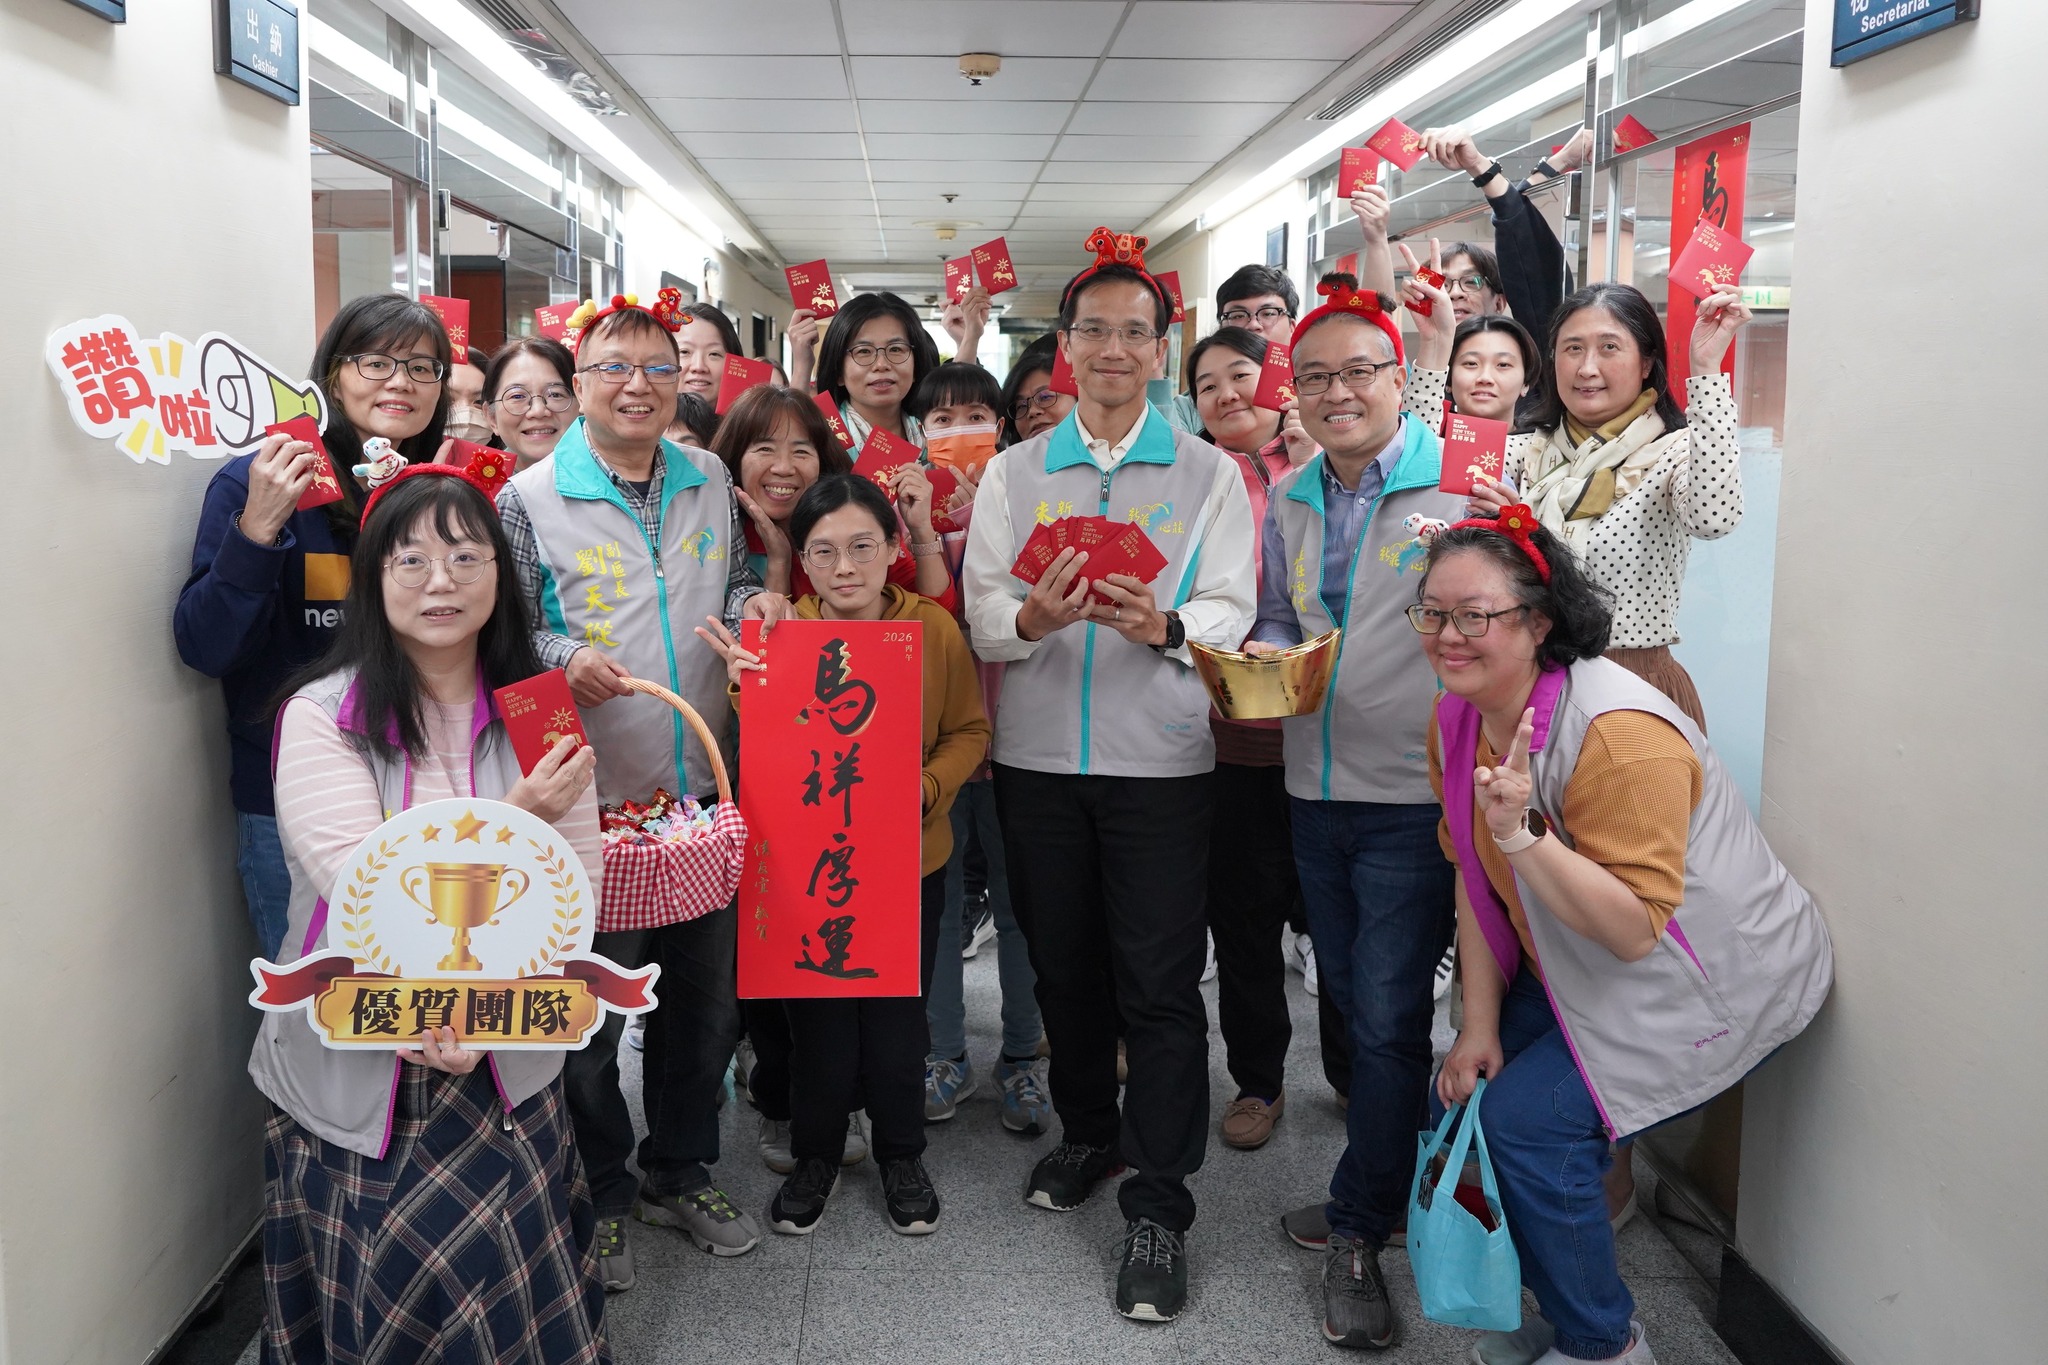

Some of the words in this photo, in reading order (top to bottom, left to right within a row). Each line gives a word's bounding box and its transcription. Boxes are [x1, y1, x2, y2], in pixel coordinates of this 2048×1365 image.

[1861, 0, 1930, 32] Secretariat
[247, 8, 282, 57] 出納
[252, 53, 279, 78] Cashier
[61, 328, 217, 446] 讚啦
[1080, 537, 1100, 545] 馬祥厚
[606, 541, 631, 599] 副區長
[575, 545, 621, 648] 劉天從
[882, 632, 913, 642] 2026
[504, 691, 516, 699] 2026
[506, 695, 523, 704] HAPPY
[521, 697, 535, 705] YEAR
[794, 638, 879, 980] 馬祥厚運
[348, 987, 572, 1036] 優質團隊
